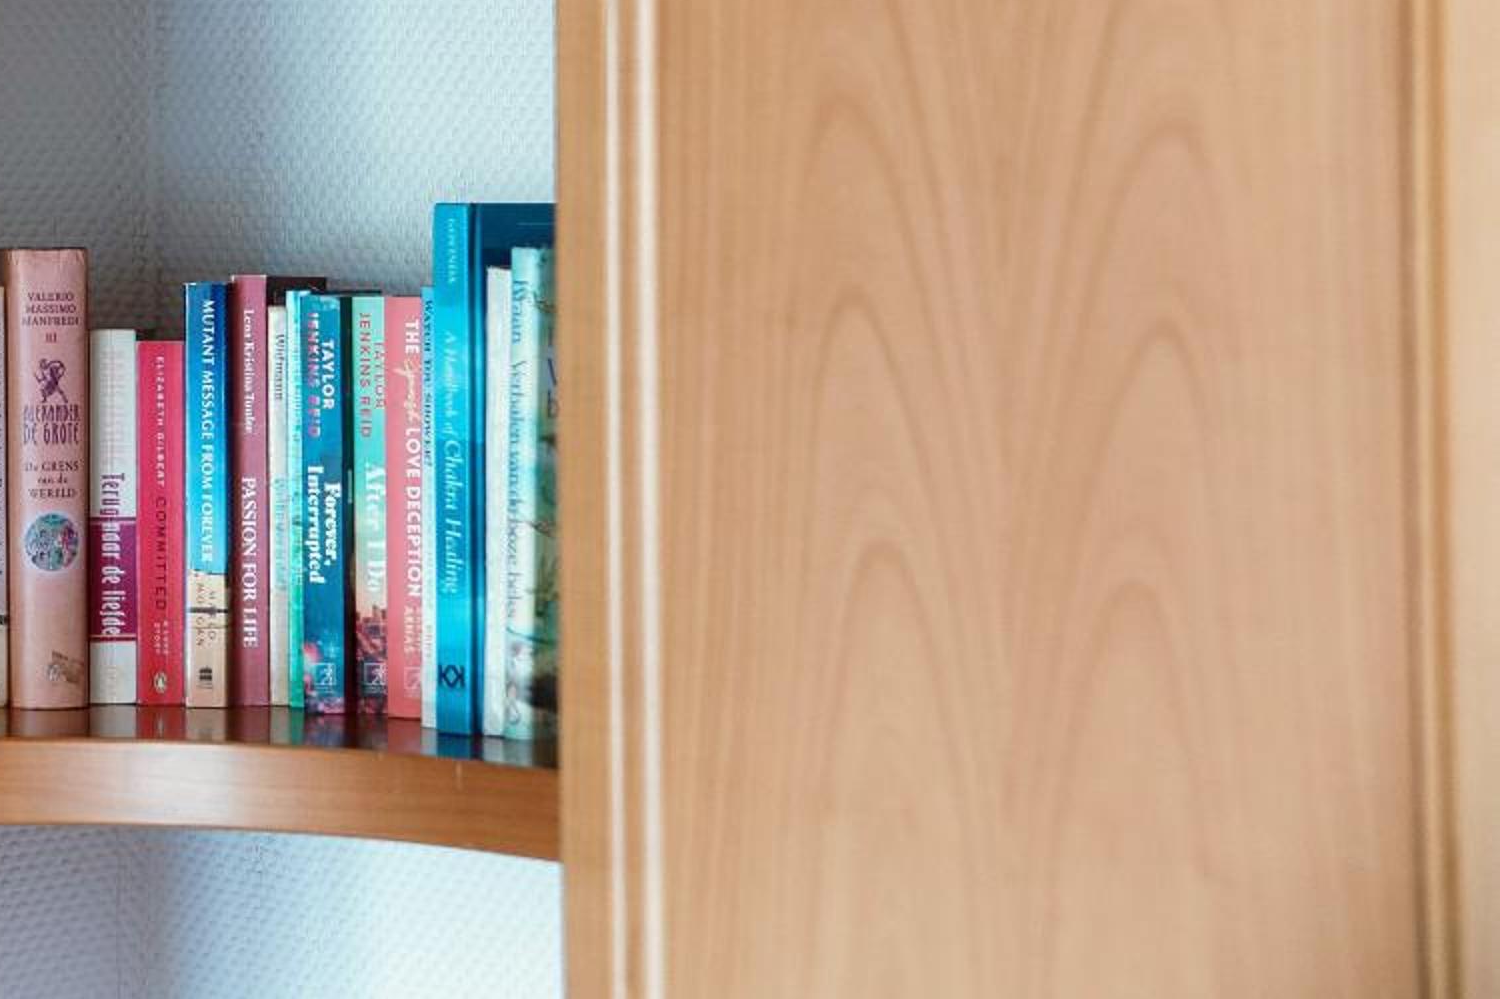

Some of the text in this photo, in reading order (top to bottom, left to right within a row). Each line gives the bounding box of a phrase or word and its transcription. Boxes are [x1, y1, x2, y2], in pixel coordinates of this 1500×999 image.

[22, 316, 79, 326] MANFREDI
[25, 305, 77, 314] MASSIMO
[27, 292, 74, 302] VALERIO
[45, 333, 58, 343] III
[405, 319, 420, 354] THE
[307, 312, 321, 438] JENKINS REID
[322, 339, 335, 410] TAYLOR
[359, 312, 371, 438] JENKINS REID
[374, 341, 385, 410] TAYLOR
[23, 404, 80, 422] ALEXANDER
[23, 424, 80, 445] DE GROTE
[201, 299, 216, 563] MUTANT MESSAGE FROM FOREVER
[441, 422, 458, 436] of
[25, 461, 80, 471] De GRENS
[406, 427, 421, 478] LOVE
[444, 440, 464, 510] Chakra
[28, 488, 77, 499] WERELD
[100, 473, 125, 516] Terug
[155, 355, 167, 611] ELIZABETH GILBERT COMMITTED
[101, 521, 121, 560] naar
[305, 465, 326, 584] Interrupted
[324, 482, 342, 567] Forever,
[366, 462, 387, 592] After I Do
[406, 485, 421, 597] DECEPTION
[101, 566, 125, 584] de
[242, 477, 259, 648] PASSION FOR LIFE
[440, 518, 463, 594] Healing
[100, 590, 127, 636] liefde
